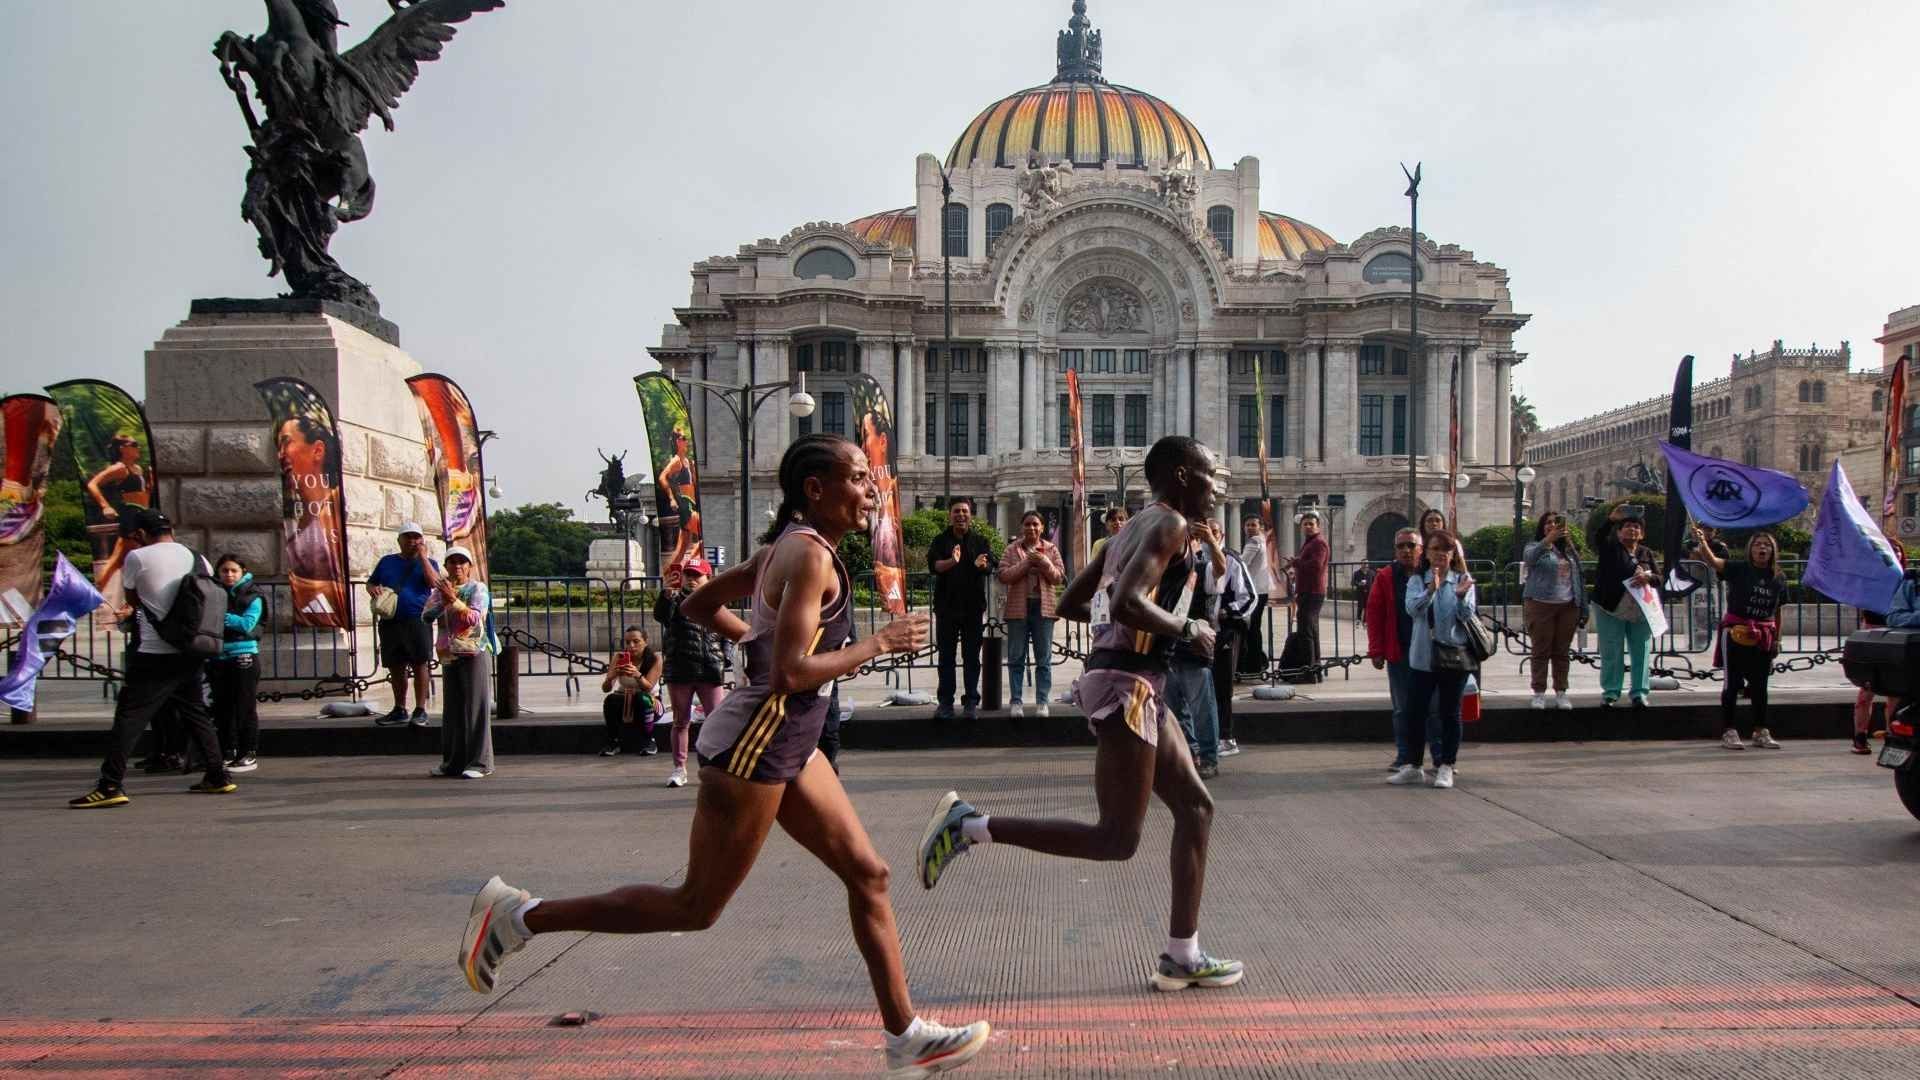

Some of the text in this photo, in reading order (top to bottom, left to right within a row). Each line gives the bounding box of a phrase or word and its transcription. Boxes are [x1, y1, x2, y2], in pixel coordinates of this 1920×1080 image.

[291, 473, 330, 489] YOU
[294, 501, 335, 517] GOT
[1752, 585, 1773, 596] YOU
